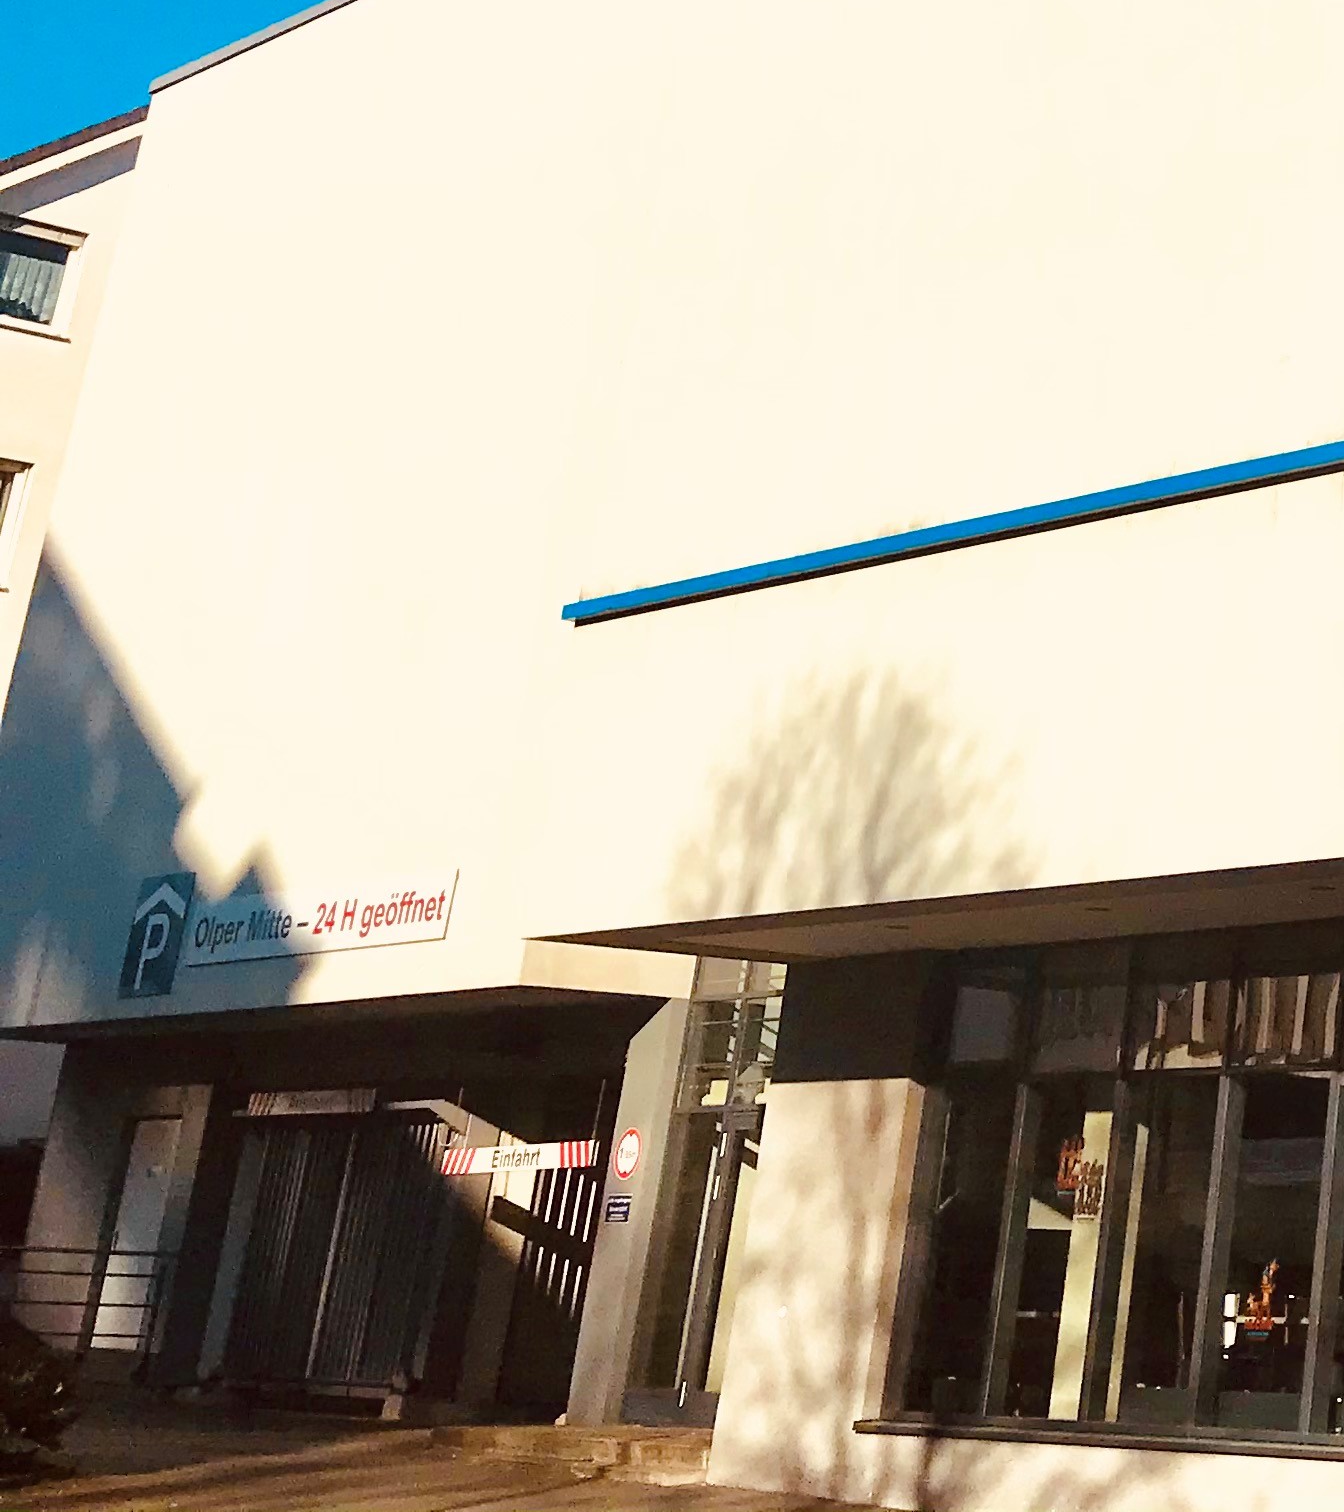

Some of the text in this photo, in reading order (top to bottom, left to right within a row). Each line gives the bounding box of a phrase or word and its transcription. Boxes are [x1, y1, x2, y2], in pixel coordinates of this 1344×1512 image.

[134, 913, 170, 990] P
[194, 916, 250, 954] Olper
[247, 908, 293, 941] Mitte
[312, 900, 338, 935] 24
[340, 898, 359, 932] H
[359, 889, 447, 938] geöffnet
[491, 1147, 541, 1169] Einfahrt
